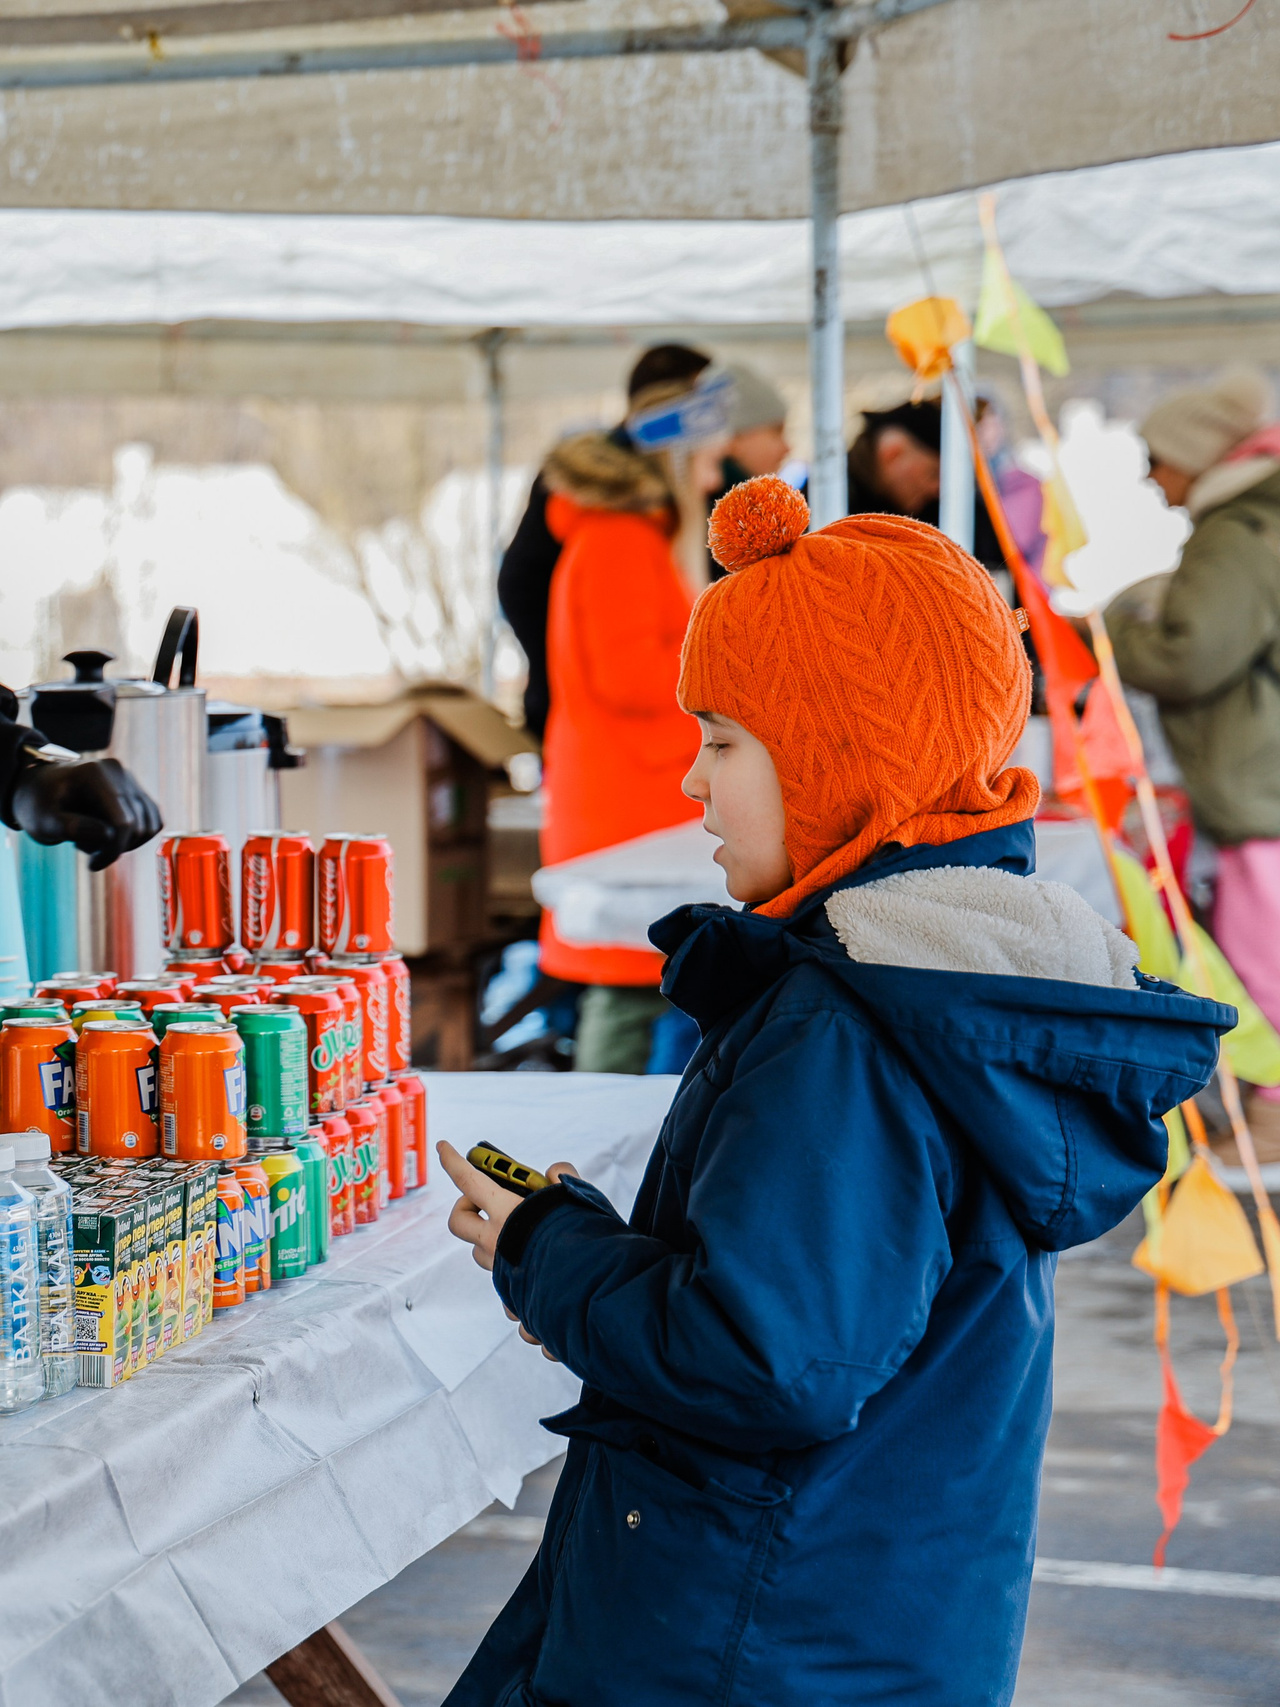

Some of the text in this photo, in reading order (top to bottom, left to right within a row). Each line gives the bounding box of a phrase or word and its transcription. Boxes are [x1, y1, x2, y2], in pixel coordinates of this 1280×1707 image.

[246, 855, 267, 942] Coca-Cola
[270, 1184, 307, 1239] rite
[10, 1242, 32, 1367] BAIKAL
[47, 1228, 69, 1352] BAIKAL
